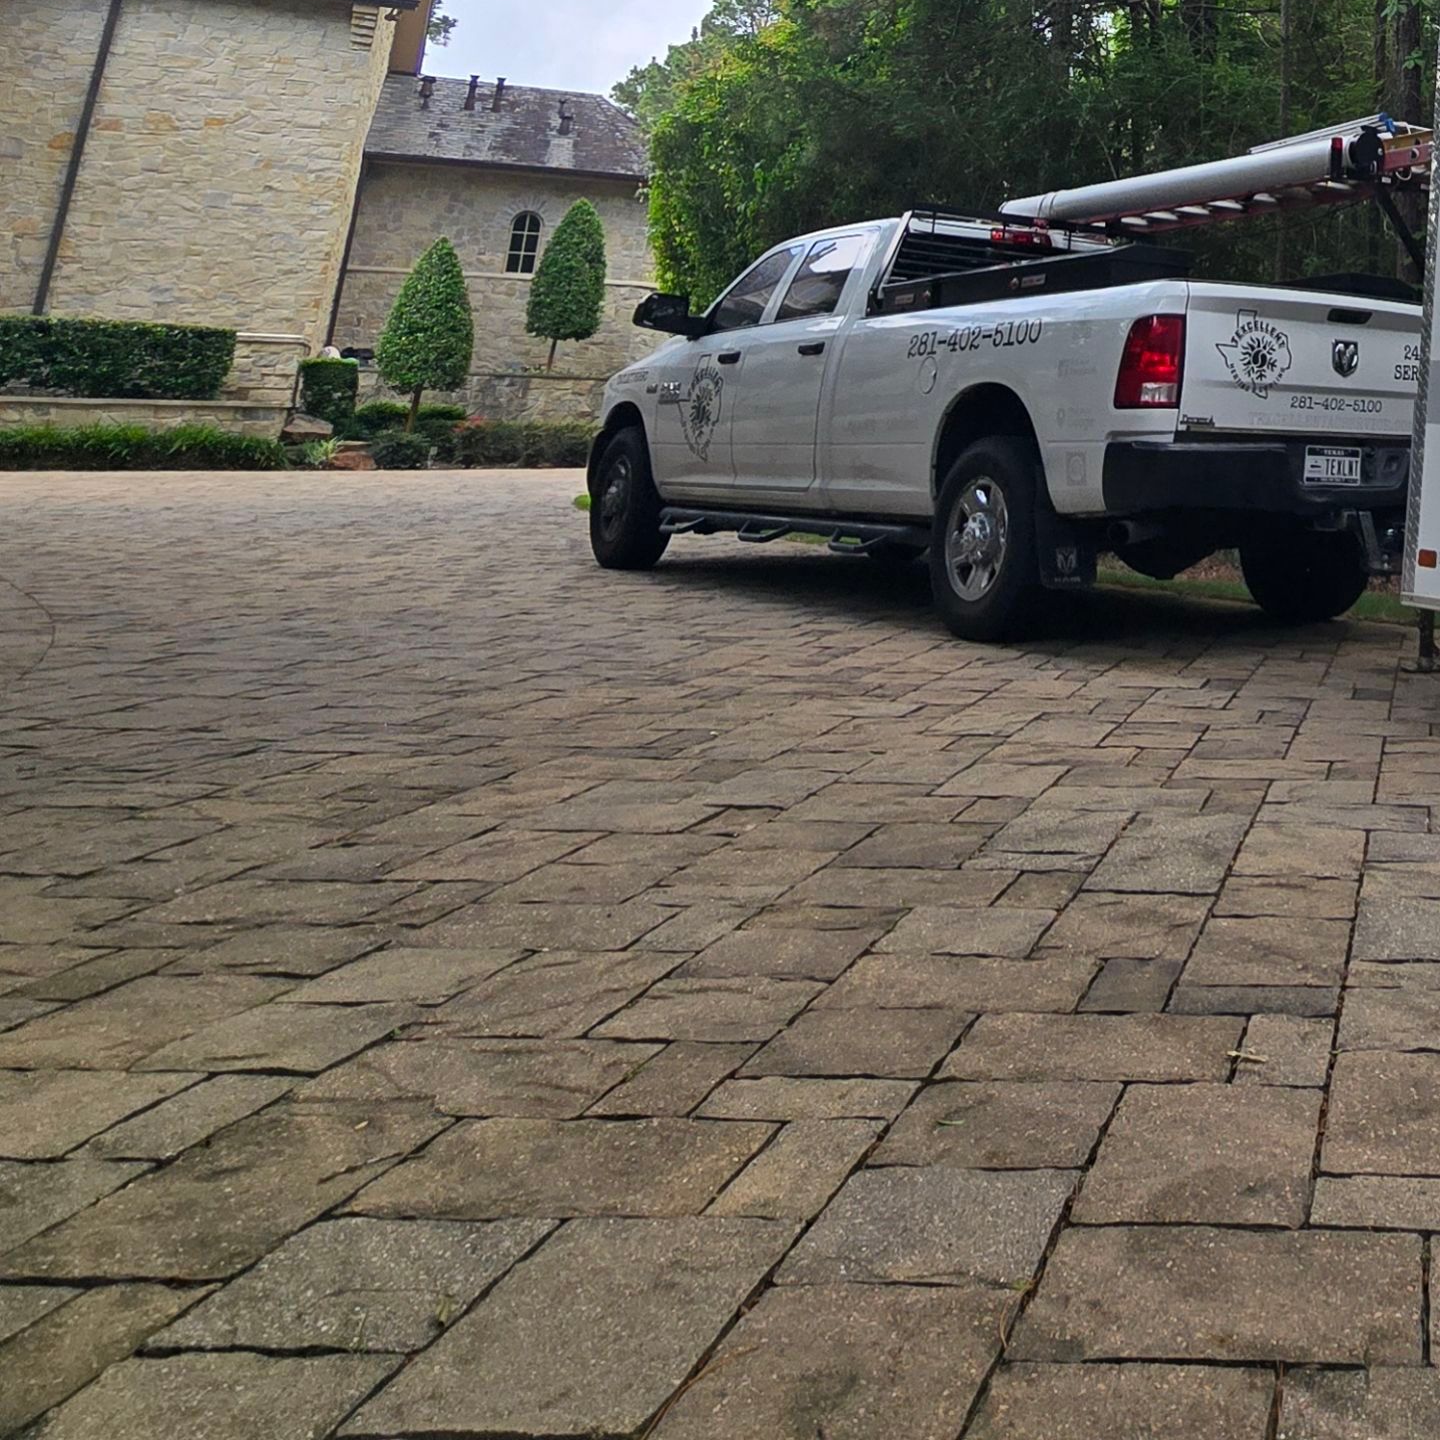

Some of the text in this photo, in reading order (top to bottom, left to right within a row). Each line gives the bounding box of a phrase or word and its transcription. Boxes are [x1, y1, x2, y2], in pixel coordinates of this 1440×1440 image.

[907, 318, 1042, 359] 281-402-5100
[1394, 365, 1420, 381] SER
[1290, 396, 1382, 413] 281-402-5100
